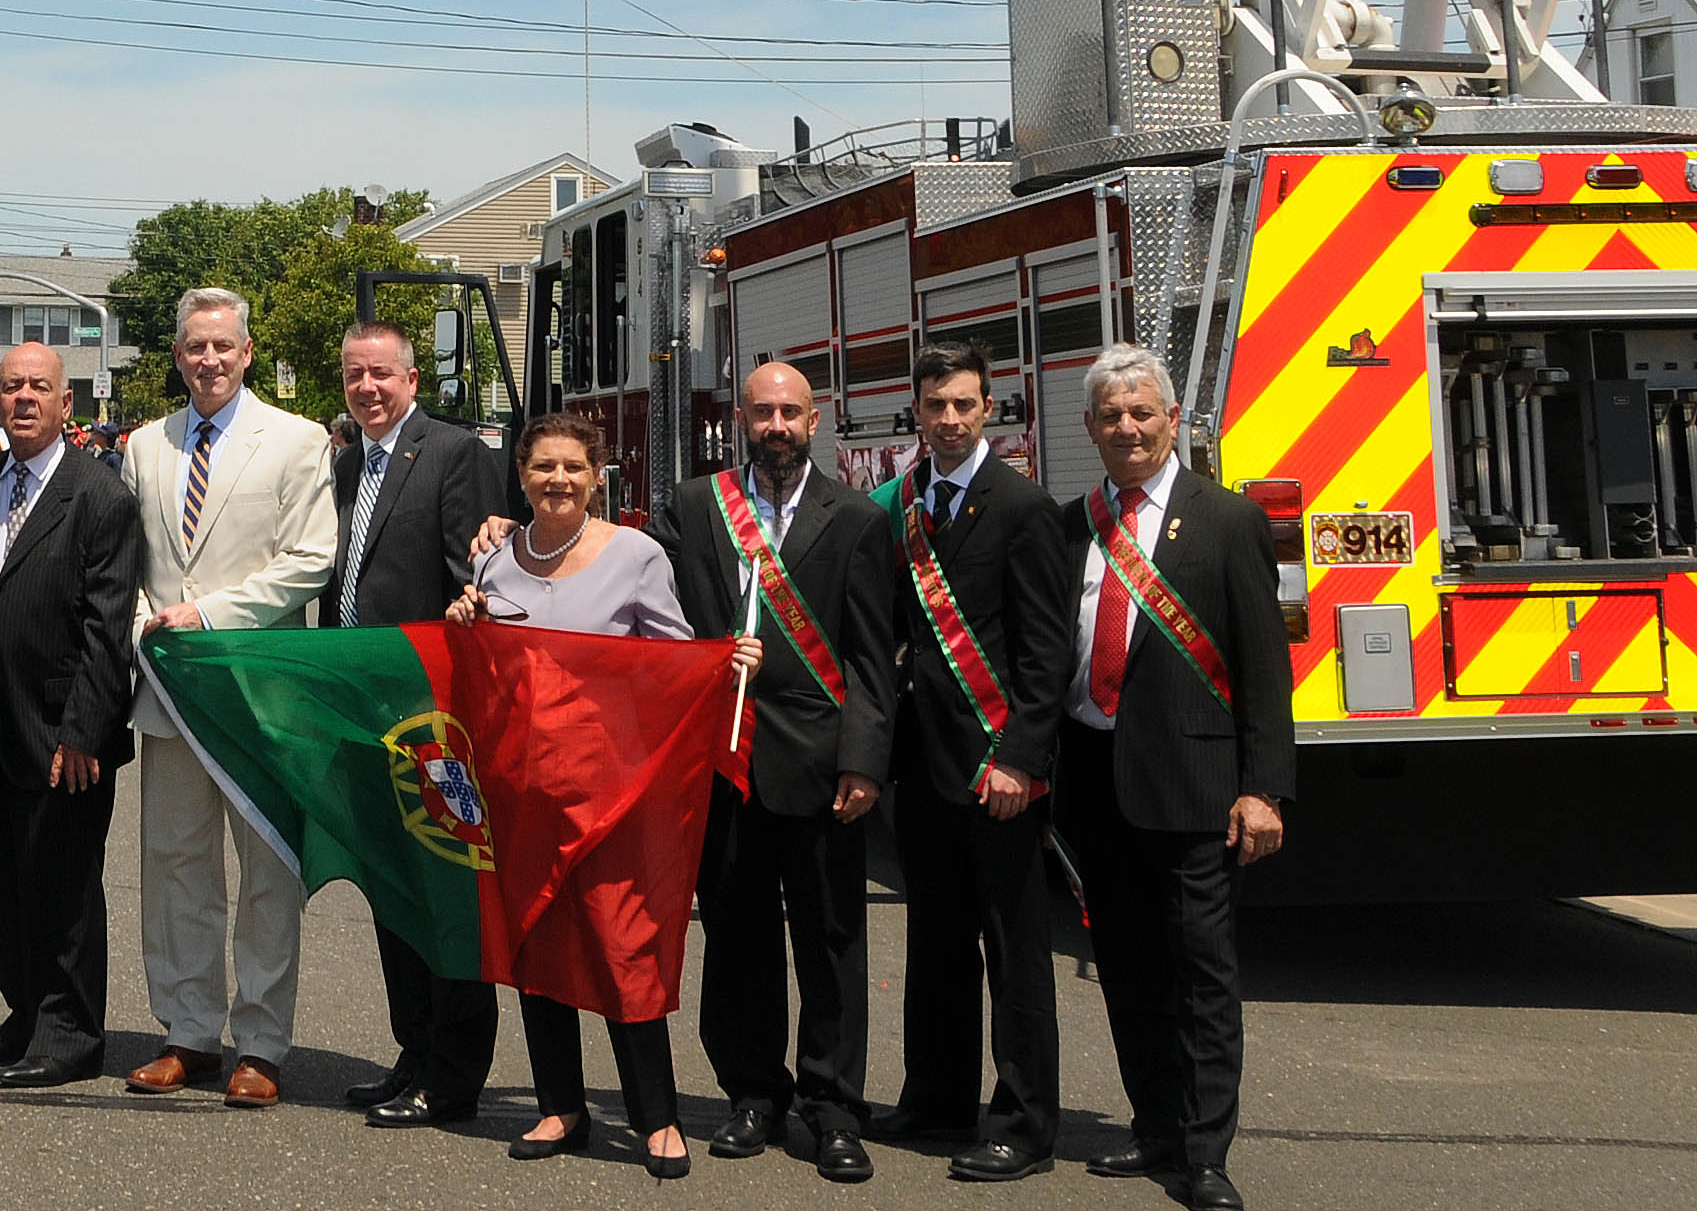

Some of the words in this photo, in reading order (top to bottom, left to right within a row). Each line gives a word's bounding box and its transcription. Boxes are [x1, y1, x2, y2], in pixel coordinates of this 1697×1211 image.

[1342, 524, 1408, 556] 914
[763, 569, 779, 583] OF
[770, 581, 790, 606] THE
[783, 603, 807, 632] YEAR
[1146, 584, 1163, 600] OF
[1156, 595, 1179, 620] THE
[1172, 614, 1197, 644] YEAR
